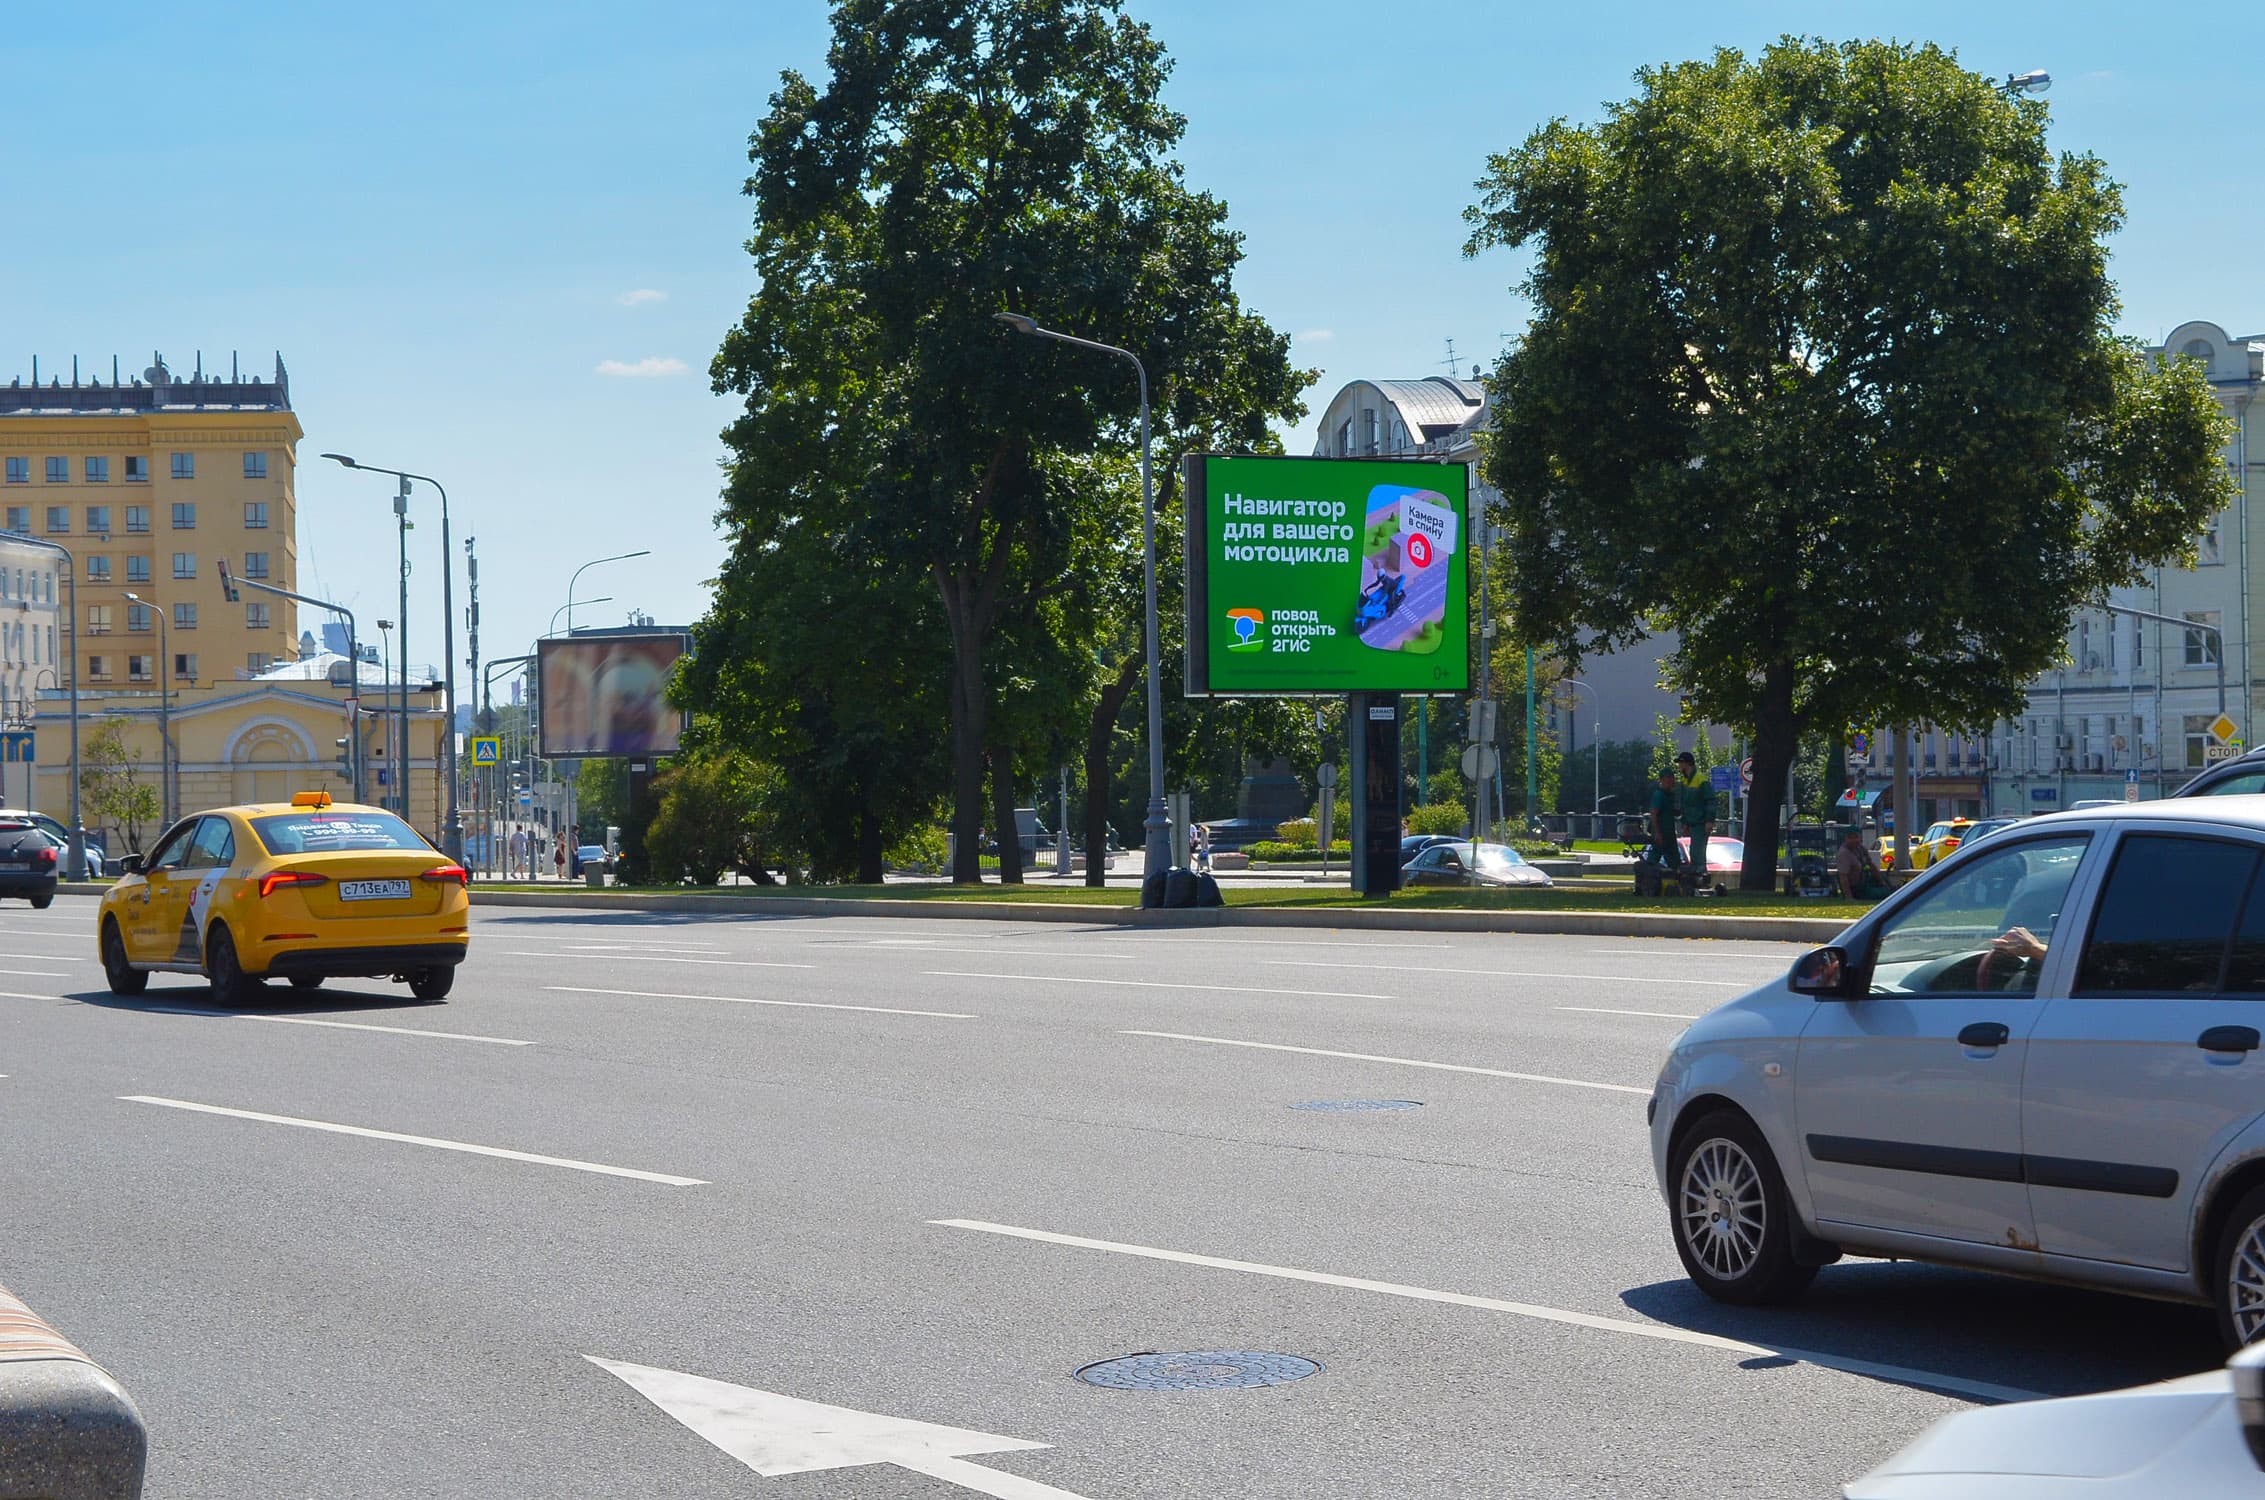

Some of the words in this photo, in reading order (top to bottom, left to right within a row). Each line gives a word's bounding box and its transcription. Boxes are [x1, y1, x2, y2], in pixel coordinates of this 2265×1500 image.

[1224, 493, 1346, 523] Навигатор
[1408, 505, 1444, 528] Камера
[1223, 522, 1265, 541] для
[1272, 523, 1354, 541] вашего
[1408, 518, 1414, 526] в
[1415, 520, 1443, 540] спину
[1224, 545, 1350, 566] мотоцикла
[1271, 624, 1336, 639] открыть
[1272, 639, 1311, 652] 2ГИС
[1433, 665, 1449, 681] 0+
[2209, 748, 2239, 757] СТОП
[344, 882, 389, 895] С713ЕА
[390, 880, 407, 891] 797
